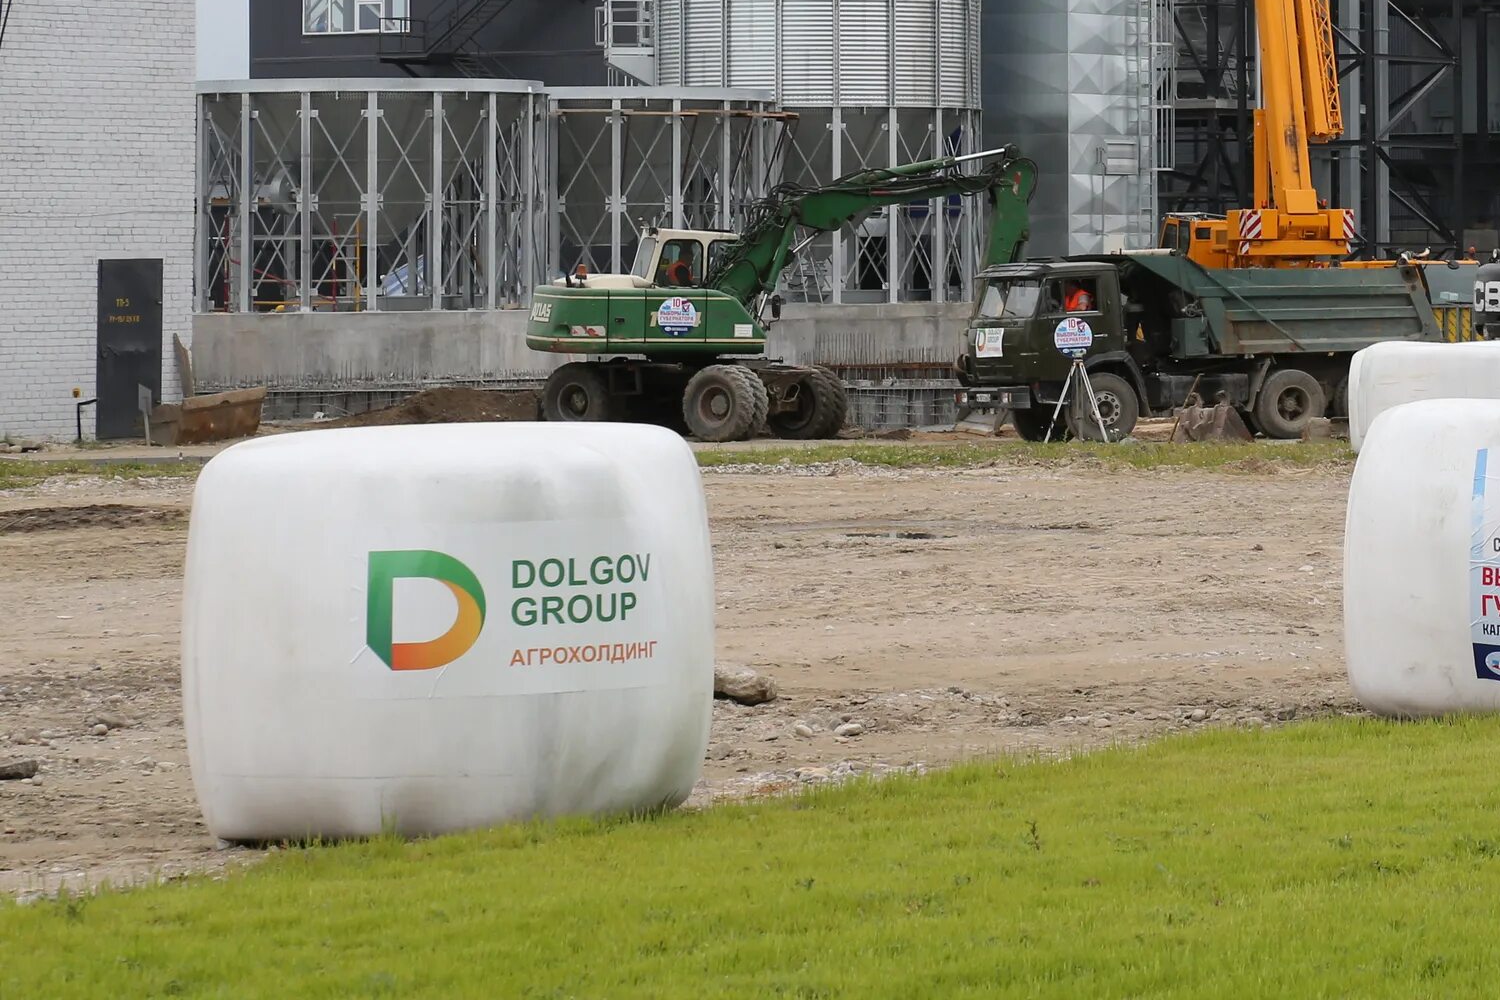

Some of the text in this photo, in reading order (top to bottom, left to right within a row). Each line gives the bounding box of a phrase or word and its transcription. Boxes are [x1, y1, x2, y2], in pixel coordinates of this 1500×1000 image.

[529, 302, 552, 322] ATLAS
[672, 298, 681, 308] 10
[1068, 319, 1076, 329] 10
[512, 553, 650, 588] DOLGOV
[511, 592, 637, 626] GROUP
[510, 641, 658, 666] АГРОХОЛДИНГ
